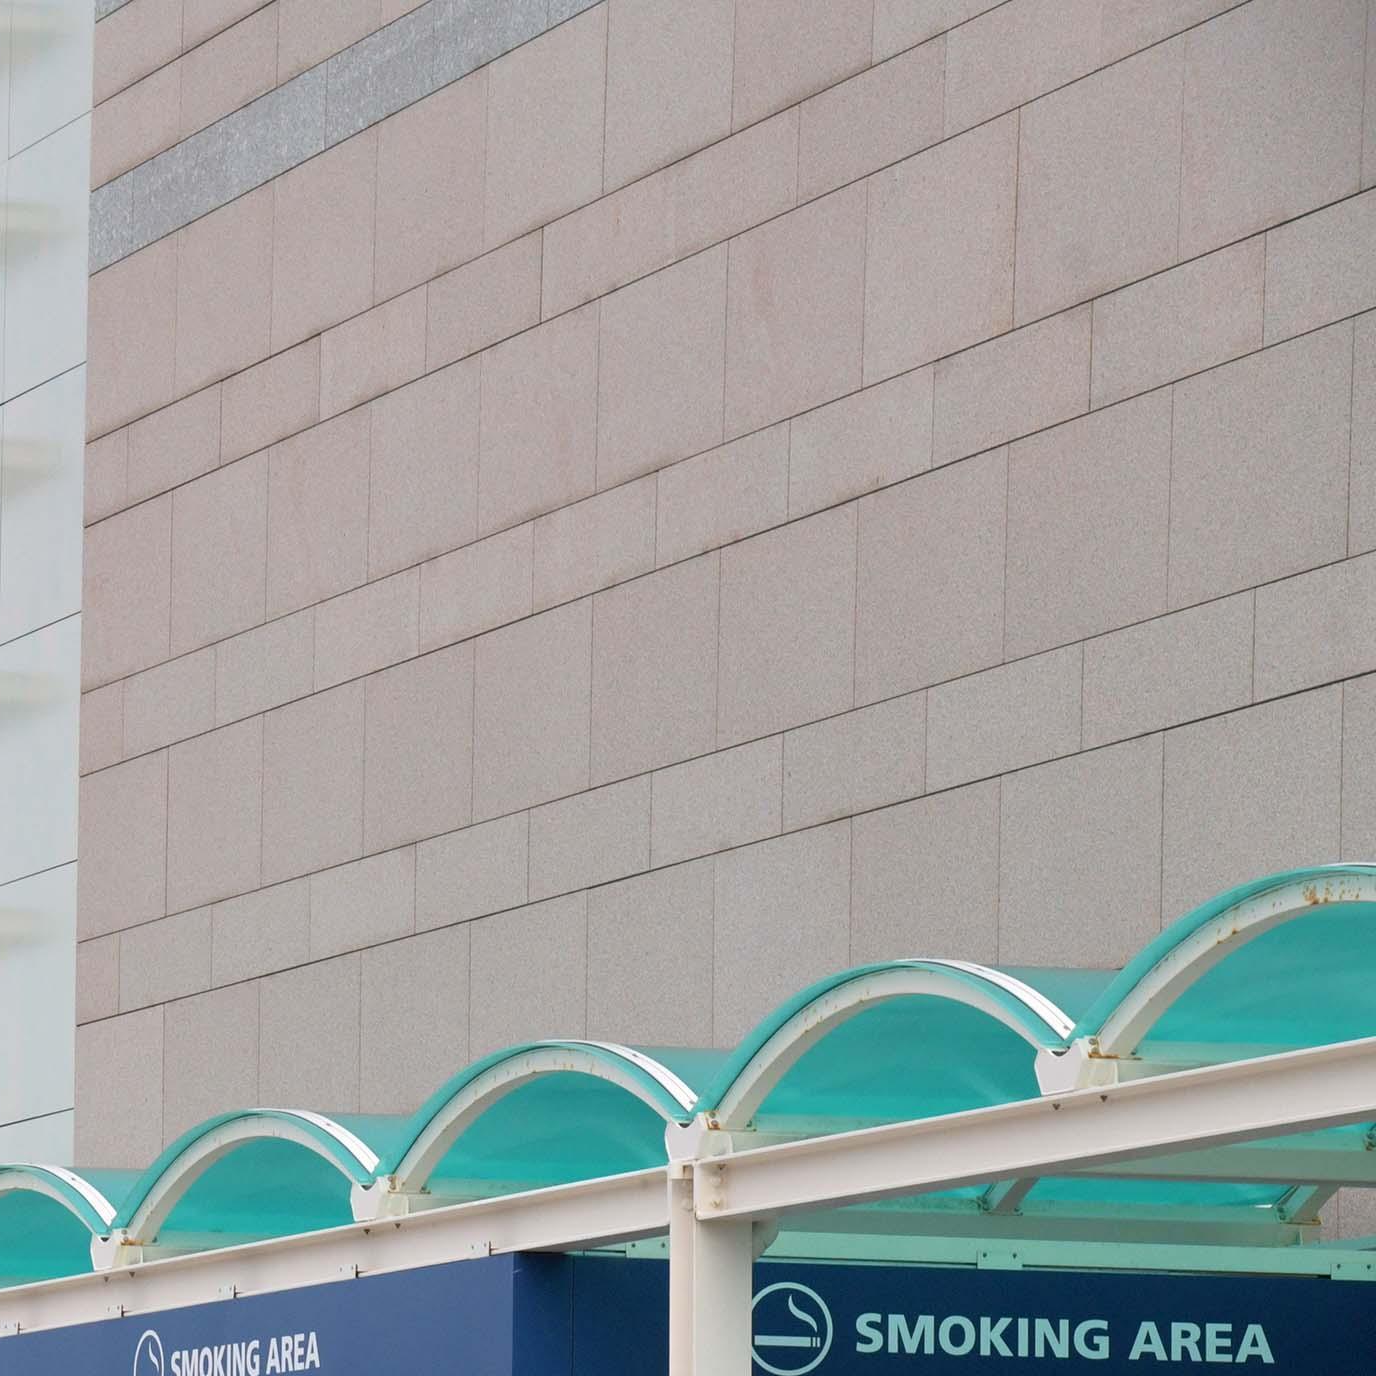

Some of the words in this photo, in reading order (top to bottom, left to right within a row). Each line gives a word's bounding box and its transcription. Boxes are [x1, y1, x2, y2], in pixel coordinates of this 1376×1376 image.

[265, 1331, 321, 1375] AREA
[855, 1312, 1110, 1360] SMOKING
[1128, 1321, 1275, 1364] AREA
